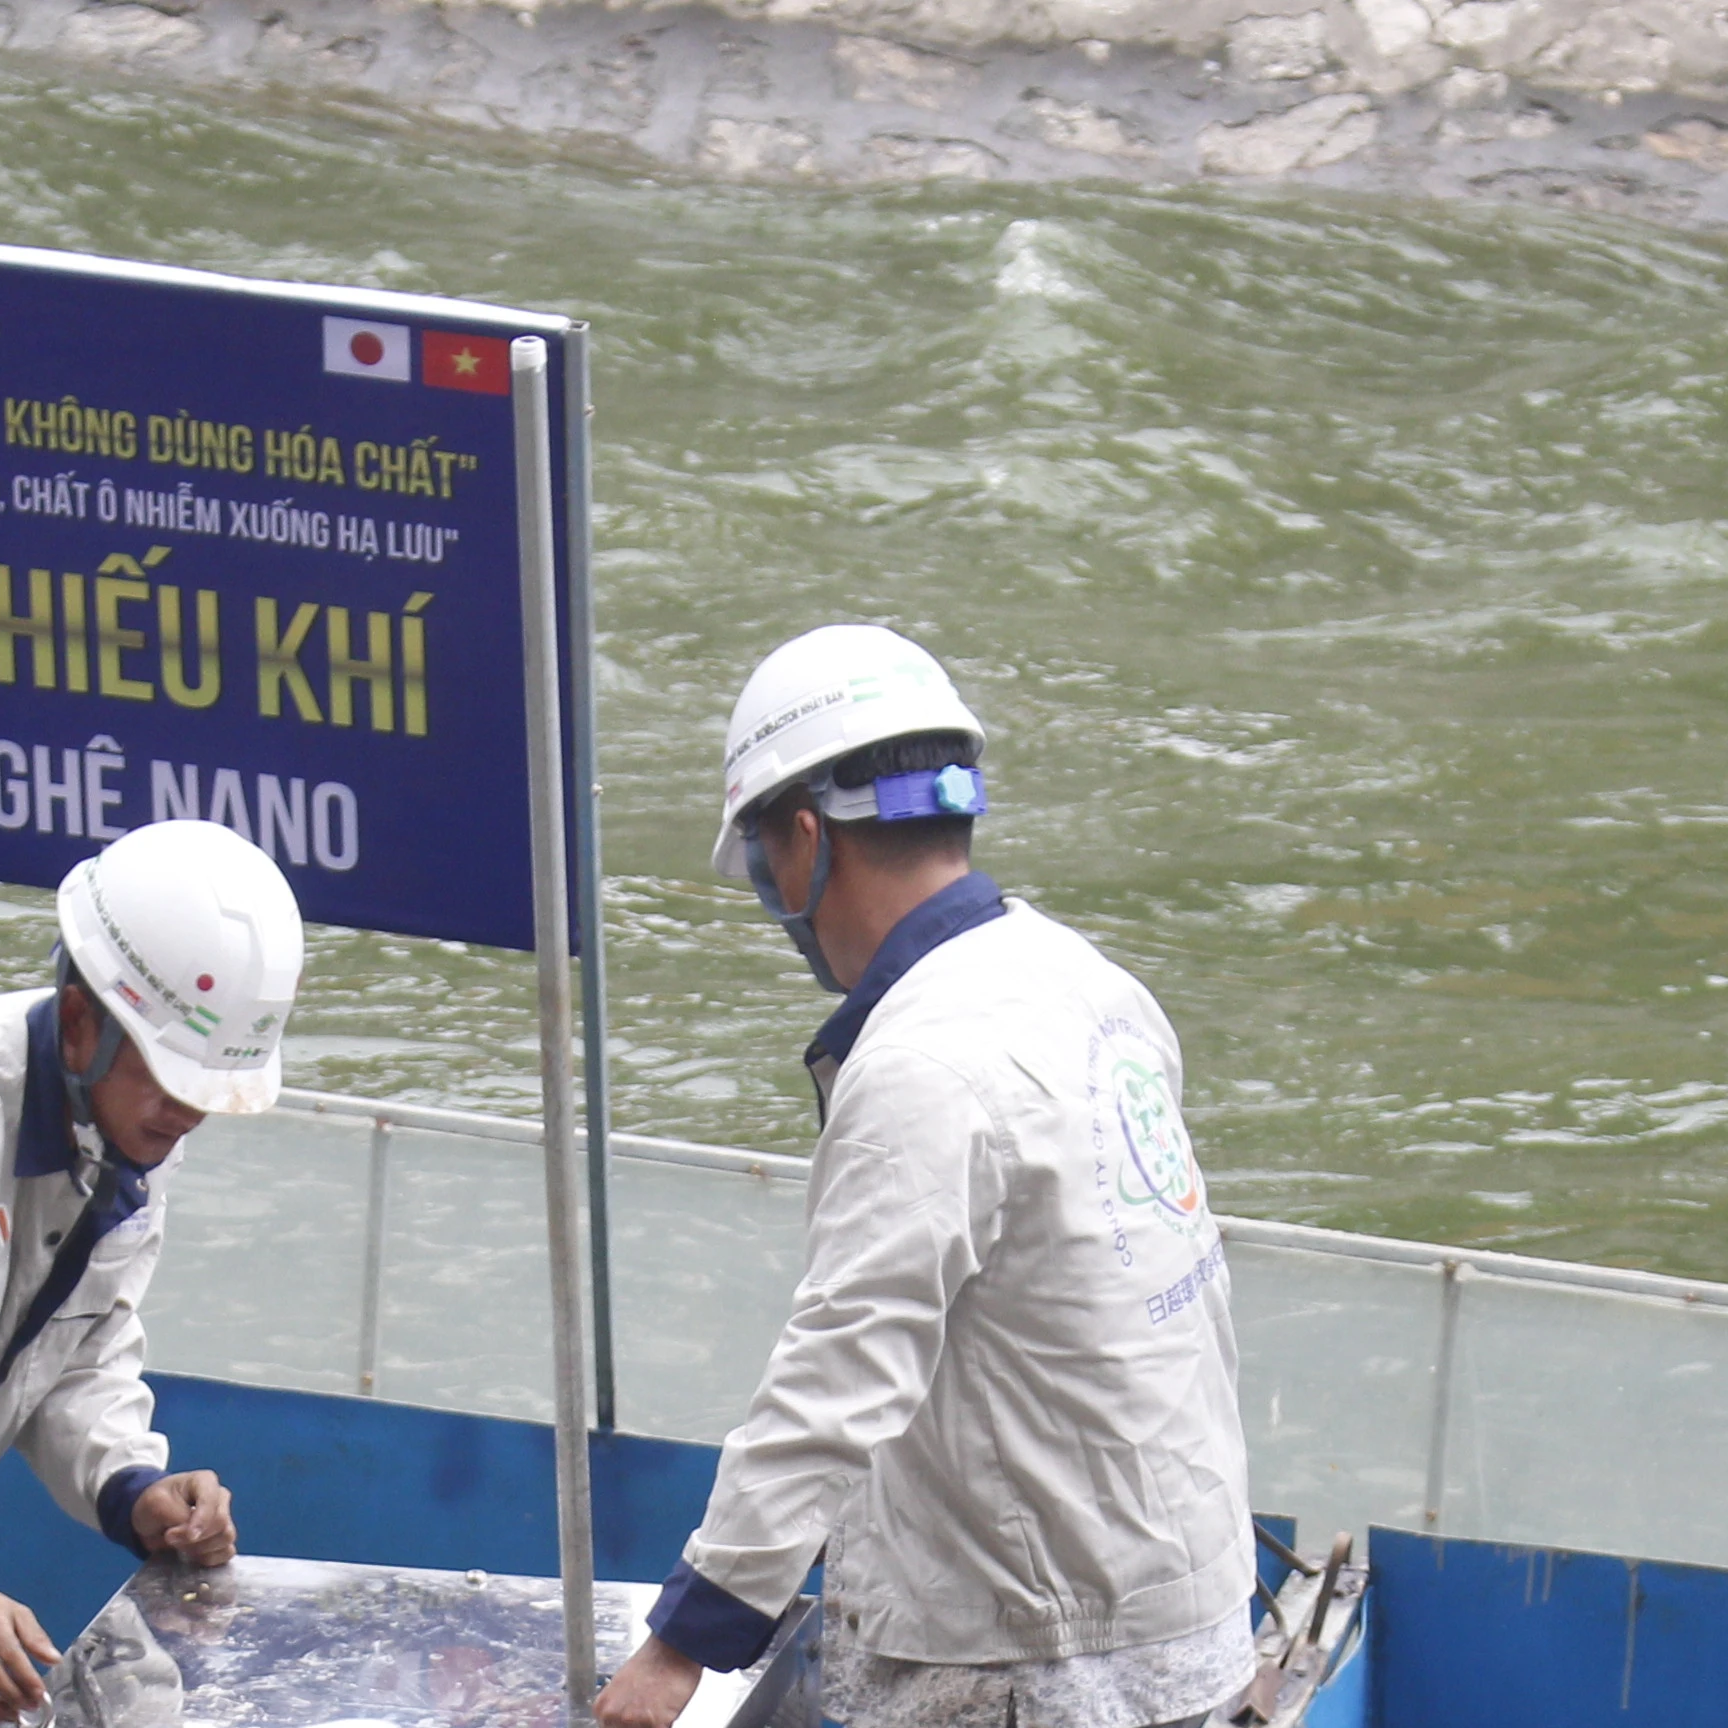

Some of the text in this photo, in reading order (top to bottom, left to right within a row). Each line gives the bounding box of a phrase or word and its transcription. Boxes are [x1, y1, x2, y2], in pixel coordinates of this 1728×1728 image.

[3, 395, 138, 460] KHÔNG
[147, 408, 255, 474] DÙNG
[264, 424, 345, 485] HÓA
[354, 435, 479, 500] CHẤT"
[12, 469, 92, 518] CHẤT
[97, 477, 118, 523] Ô
[125, 481, 222, 535] NHIỄM
[228, 496, 329, 549] XUỐNG
[337, 517, 380, 562] HẠ
[387, 521, 459, 564] LƯU"
[254, 591, 436, 738] KHÍ
[150, 758, 360, 871] NANO
